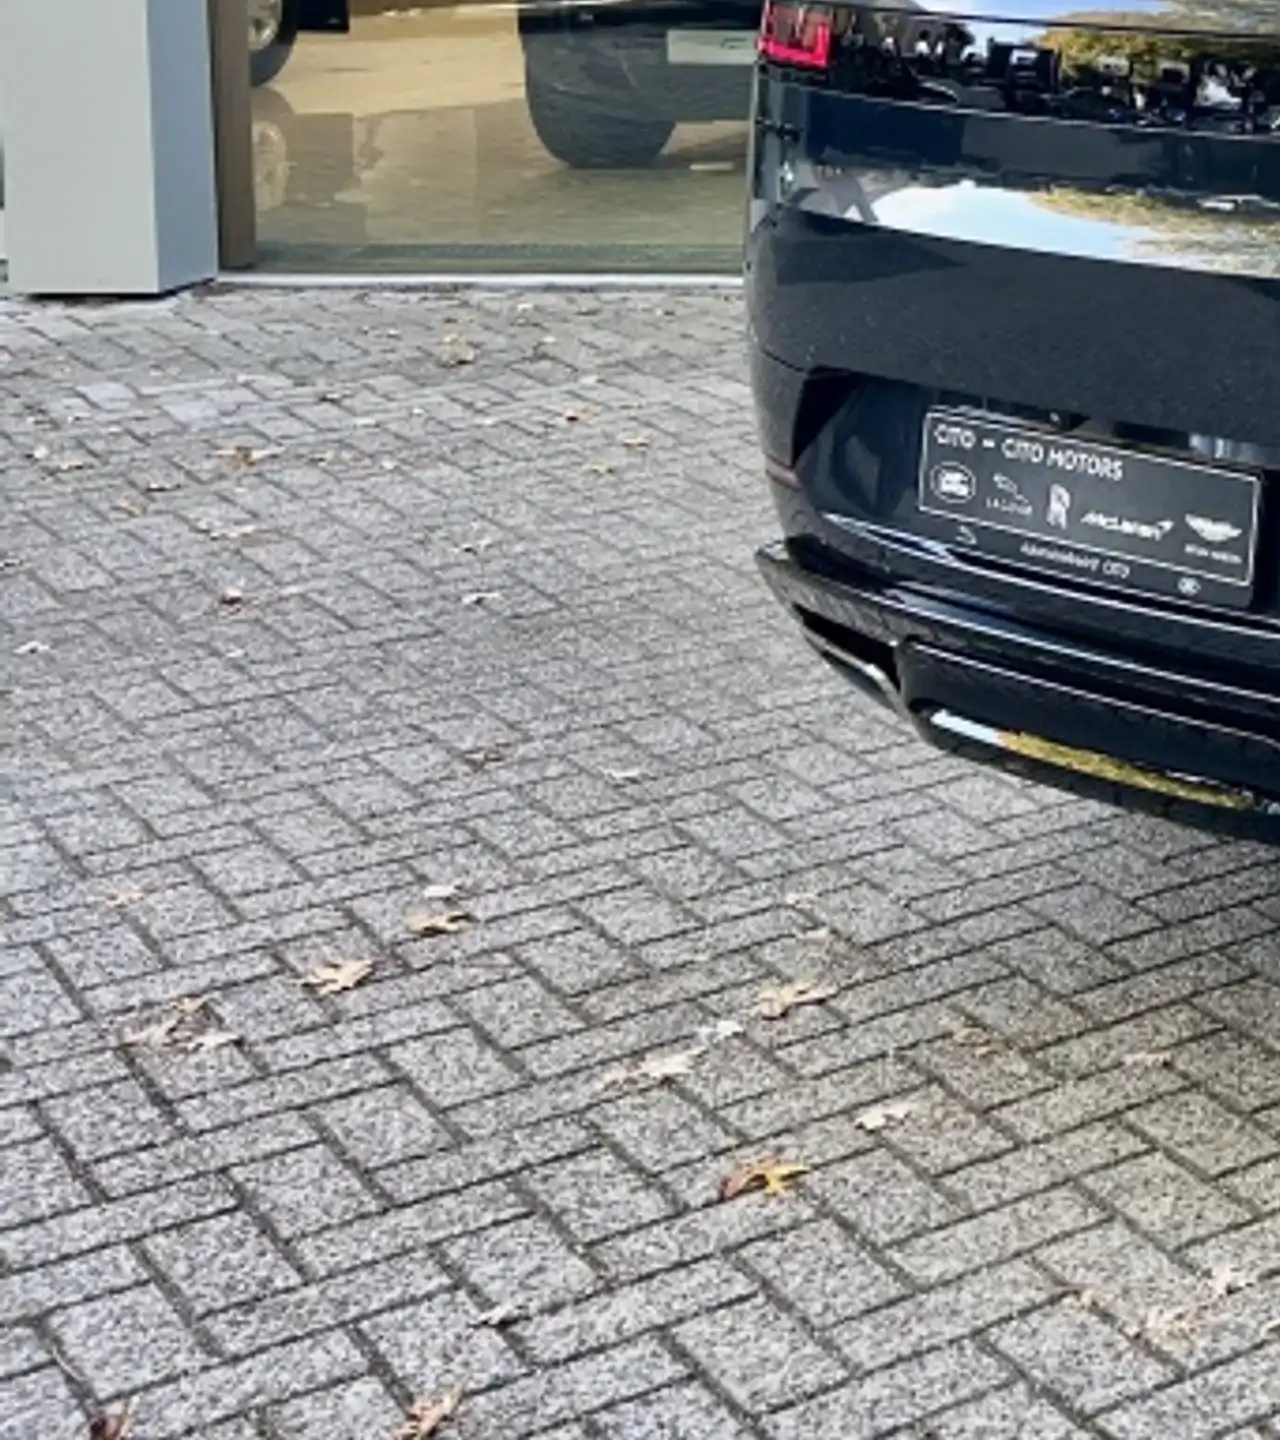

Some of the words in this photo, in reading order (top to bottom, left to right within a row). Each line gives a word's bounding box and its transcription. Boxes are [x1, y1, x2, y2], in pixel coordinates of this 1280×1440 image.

[934, 423, 977, 450] CITO
[1001, 437, 1044, 464] CITO
[1046, 446, 1124, 482] MOTORS
